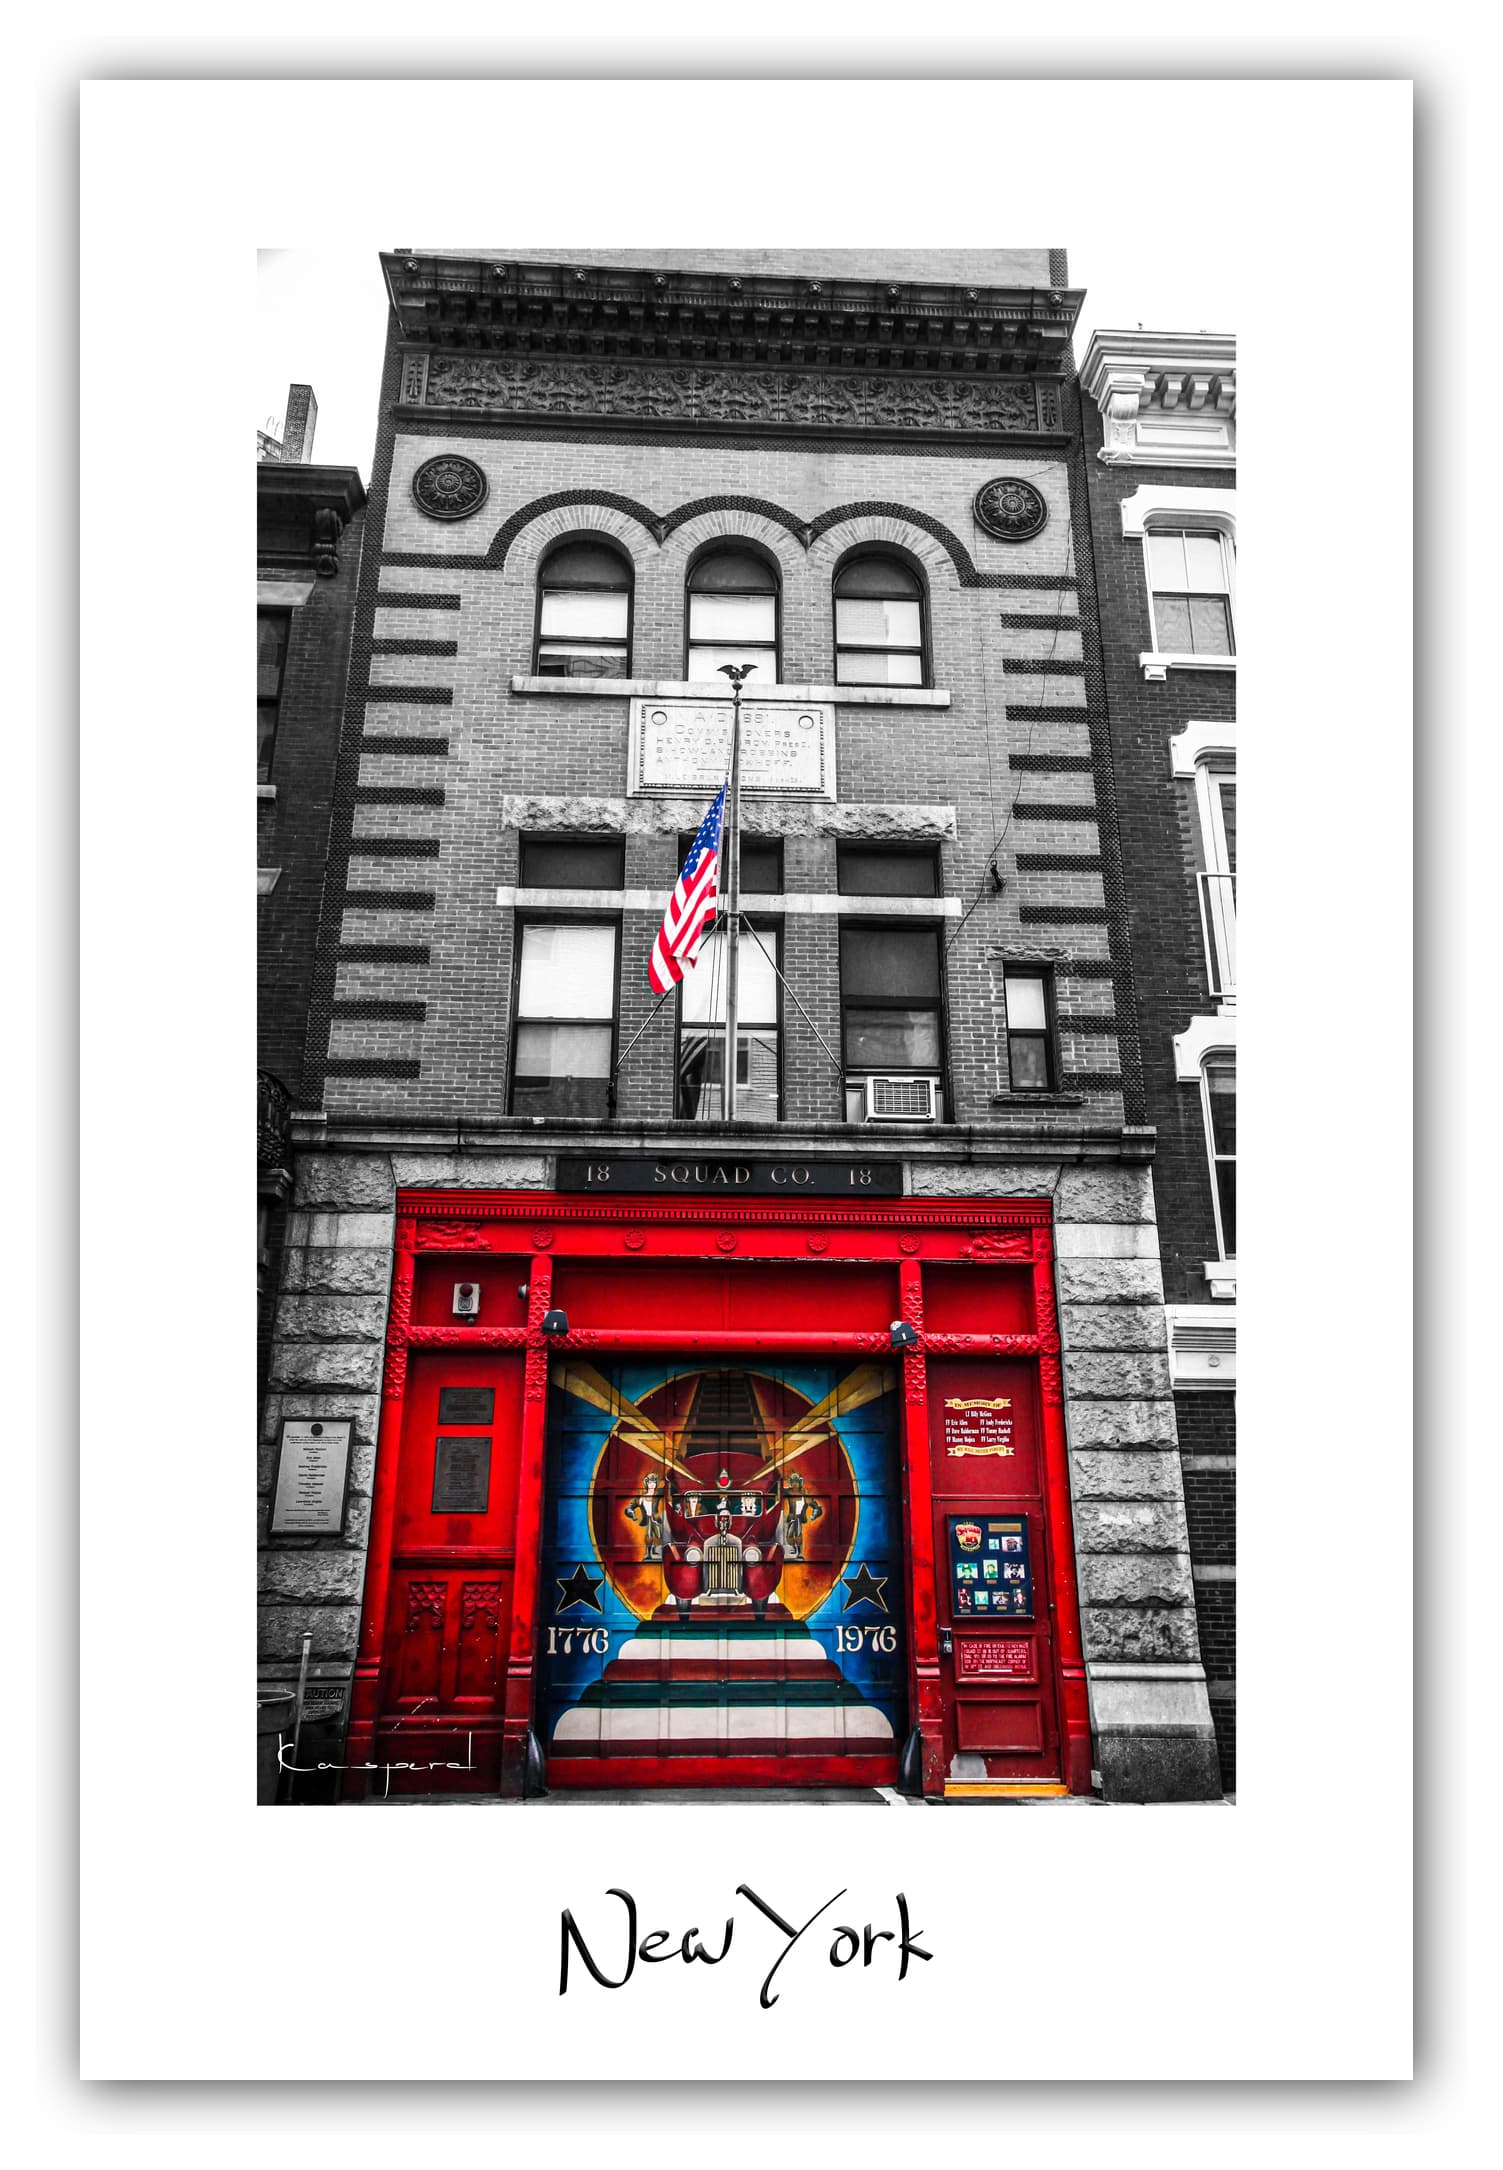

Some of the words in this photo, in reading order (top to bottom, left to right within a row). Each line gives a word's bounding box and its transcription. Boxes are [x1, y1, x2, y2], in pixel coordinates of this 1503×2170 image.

[587, 1165, 610, 1182] 18
[654, 1165, 750, 1184] SQUAD
[771, 1167, 815, 1184] CO.
[849, 1168, 872, 1185] 18
[547, 1625, 610, 1655] 1776
[835, 1625, 898, 1653] 1976
